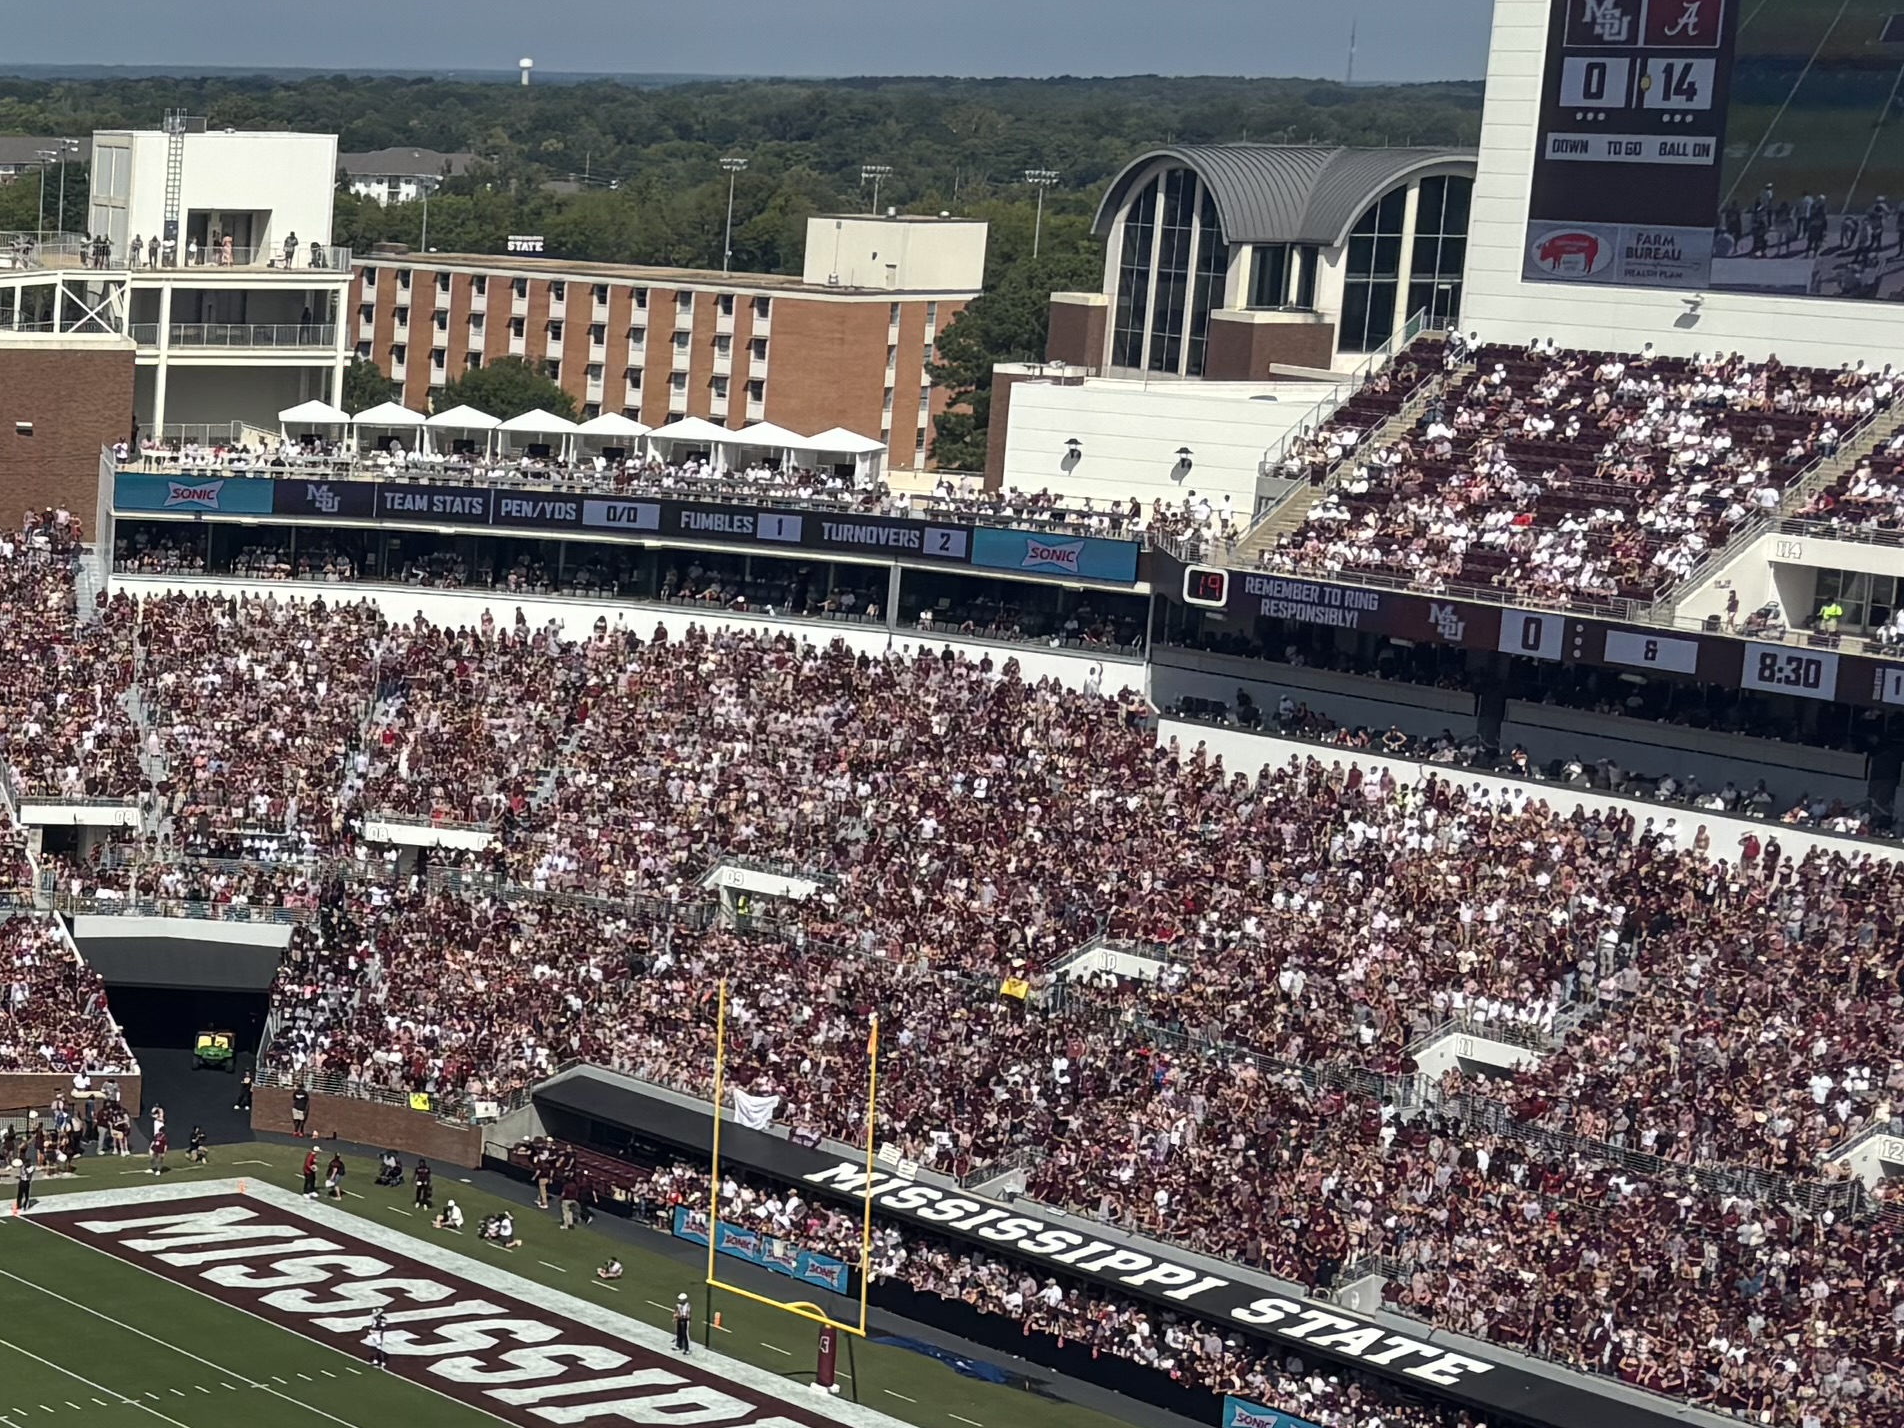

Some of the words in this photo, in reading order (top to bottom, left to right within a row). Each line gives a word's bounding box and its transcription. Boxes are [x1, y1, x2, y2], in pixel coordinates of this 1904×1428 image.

[1664, 0, 1699, 38] A
[1583, 60, 1606, 101] 0
[1661, 61, 1698, 103] 14
[1552, 138, 1590, 156] DOWN
[1606, 140, 1621, 156] TO
[1624, 140, 1642, 157] GO
[1658, 140, 1690, 158] BALL
[1693, 142, 1711, 158] ON
[1624, 246, 1682, 261] BUREAU
[1636, 233, 1675, 247] FARM
[171, 487, 216, 501] SONIC
[384, 492, 430, 513] TEAM
[432, 495, 484, 515] STATS
[500, 498, 577, 521] PEN/YDS
[605, 505, 638, 523] 0/0
[679, 511, 754, 534] FUMBLES
[821, 521, 920, 548] TURNOVERS
[939, 533, 952, 551] 2
[1028, 546, 1076, 565] SONIC
[1776, 541, 1803, 560] 114
[1197, 573, 1221, 598] 19
[1245, 576, 1322, 604] REMEMBER
[1323, 586, 1342, 605] TO
[1345, 588, 1379, 612] RING
[1260, 598, 1359, 629] RESPONSIBLY!
[1520, 616, 1543, 651] 0
[1644, 639, 1658, 662] &
[1757, 651, 1823, 689] 8:30
[803, 1160, 1229, 1304] MISSISSIPPI
[1230, 1296, 1495, 1386] STATE
